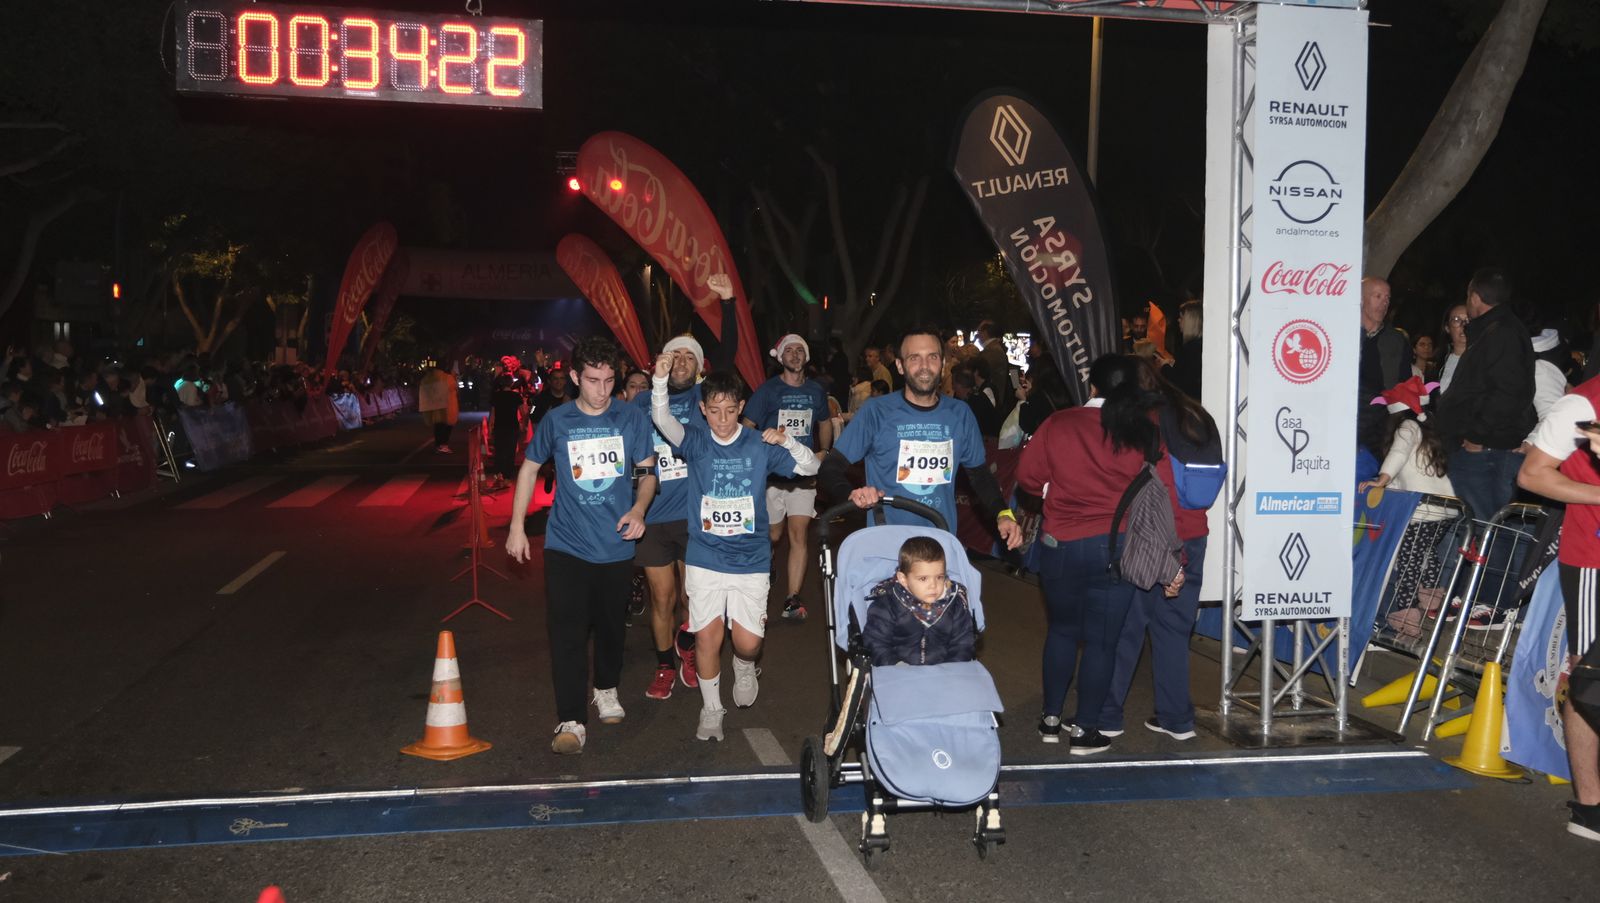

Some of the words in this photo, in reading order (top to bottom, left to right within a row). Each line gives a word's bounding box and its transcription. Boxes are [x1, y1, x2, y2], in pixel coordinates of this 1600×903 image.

[1269, 101, 1349, 118] RENAULT
[1269, 116, 1293, 127] SYRSA
[1295, 117, 1347, 129] AUTOMOCION
[1269, 185, 1343, 200] NISSAN
[1275, 226, 1340, 238] andalmotor.es
[1261, 260, 1353, 297] Coca-Cola
[786, 418, 805, 428] 281
[1291, 429, 1330, 475] Paquita
[906, 456, 949, 470] 1099
[1259, 495, 1316, 511] Almericar
[712, 510, 742, 523] 603
[1254, 592, 1332, 605] RENAULT
[1255, 605, 1279, 616] SYRSA
[1280, 605, 1331, 616] AUTOMOCION
